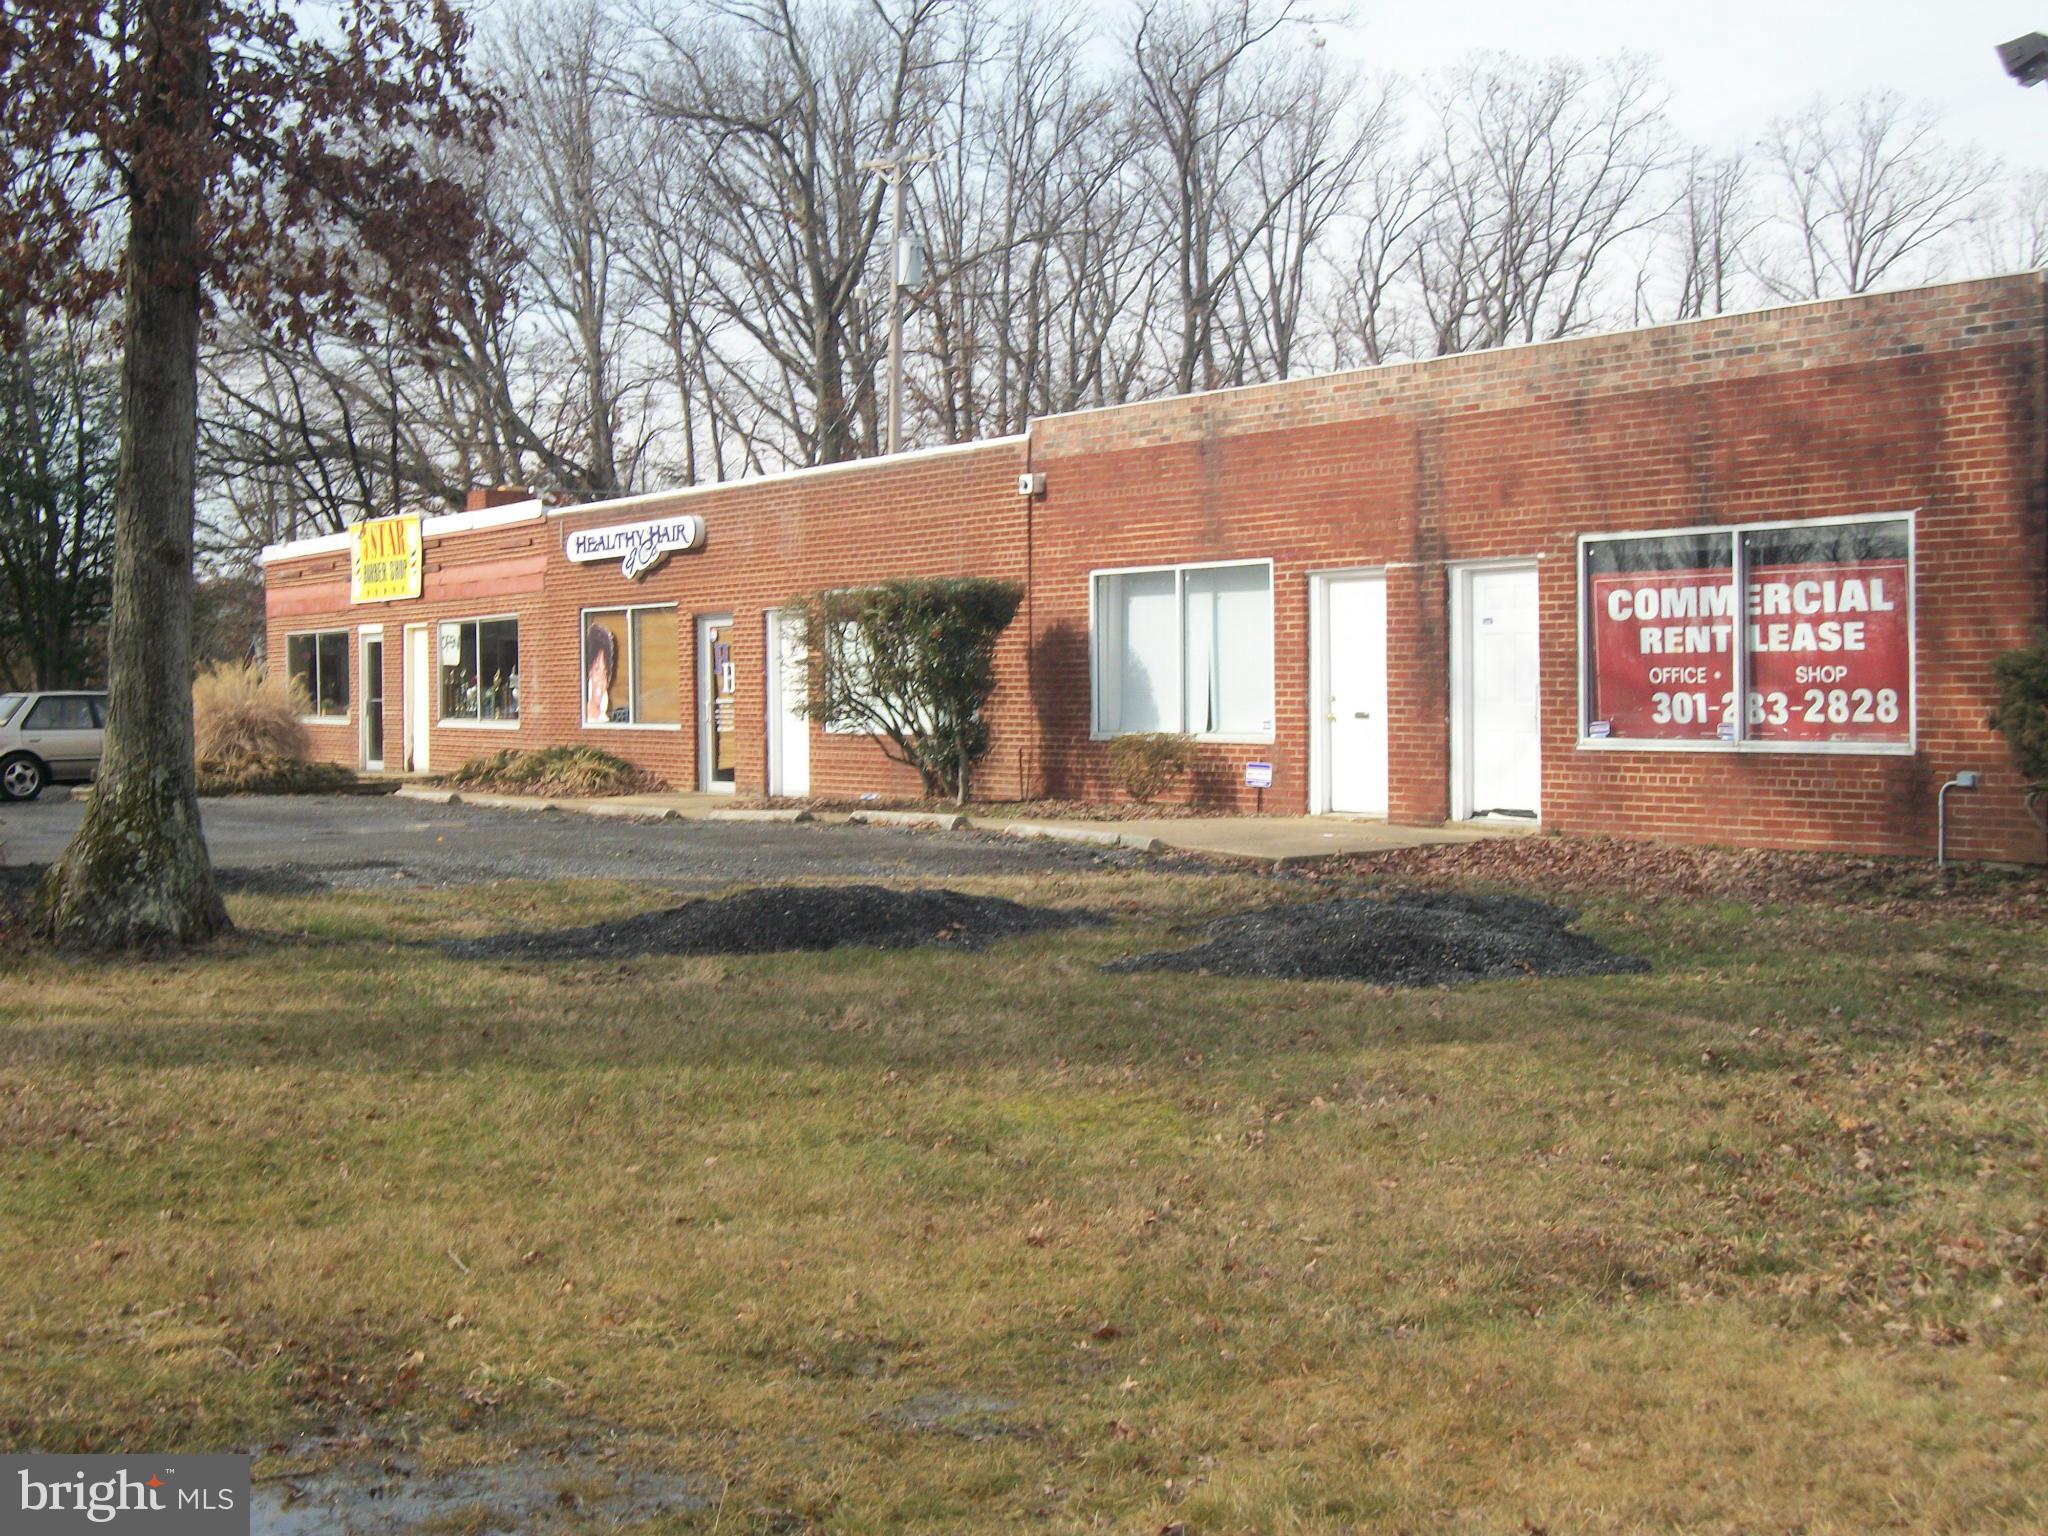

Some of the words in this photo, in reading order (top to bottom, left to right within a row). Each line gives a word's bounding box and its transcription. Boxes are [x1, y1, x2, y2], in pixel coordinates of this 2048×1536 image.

[370, 519, 406, 560] STAR
[575, 529, 646, 554] HEALTHY
[646, 524, 690, 546] HAIR
[389, 559, 408, 581] SHOP
[1607, 578, 1895, 622] COMMERCIAL
[1640, 625, 1732, 655] RENT
[1747, 621, 1866, 653] LEASE
[1649, 666, 1708, 685] OFFICE
[1795, 665, 1848, 684] SHOP
[1651, 687, 1899, 725] 301-283-2828
